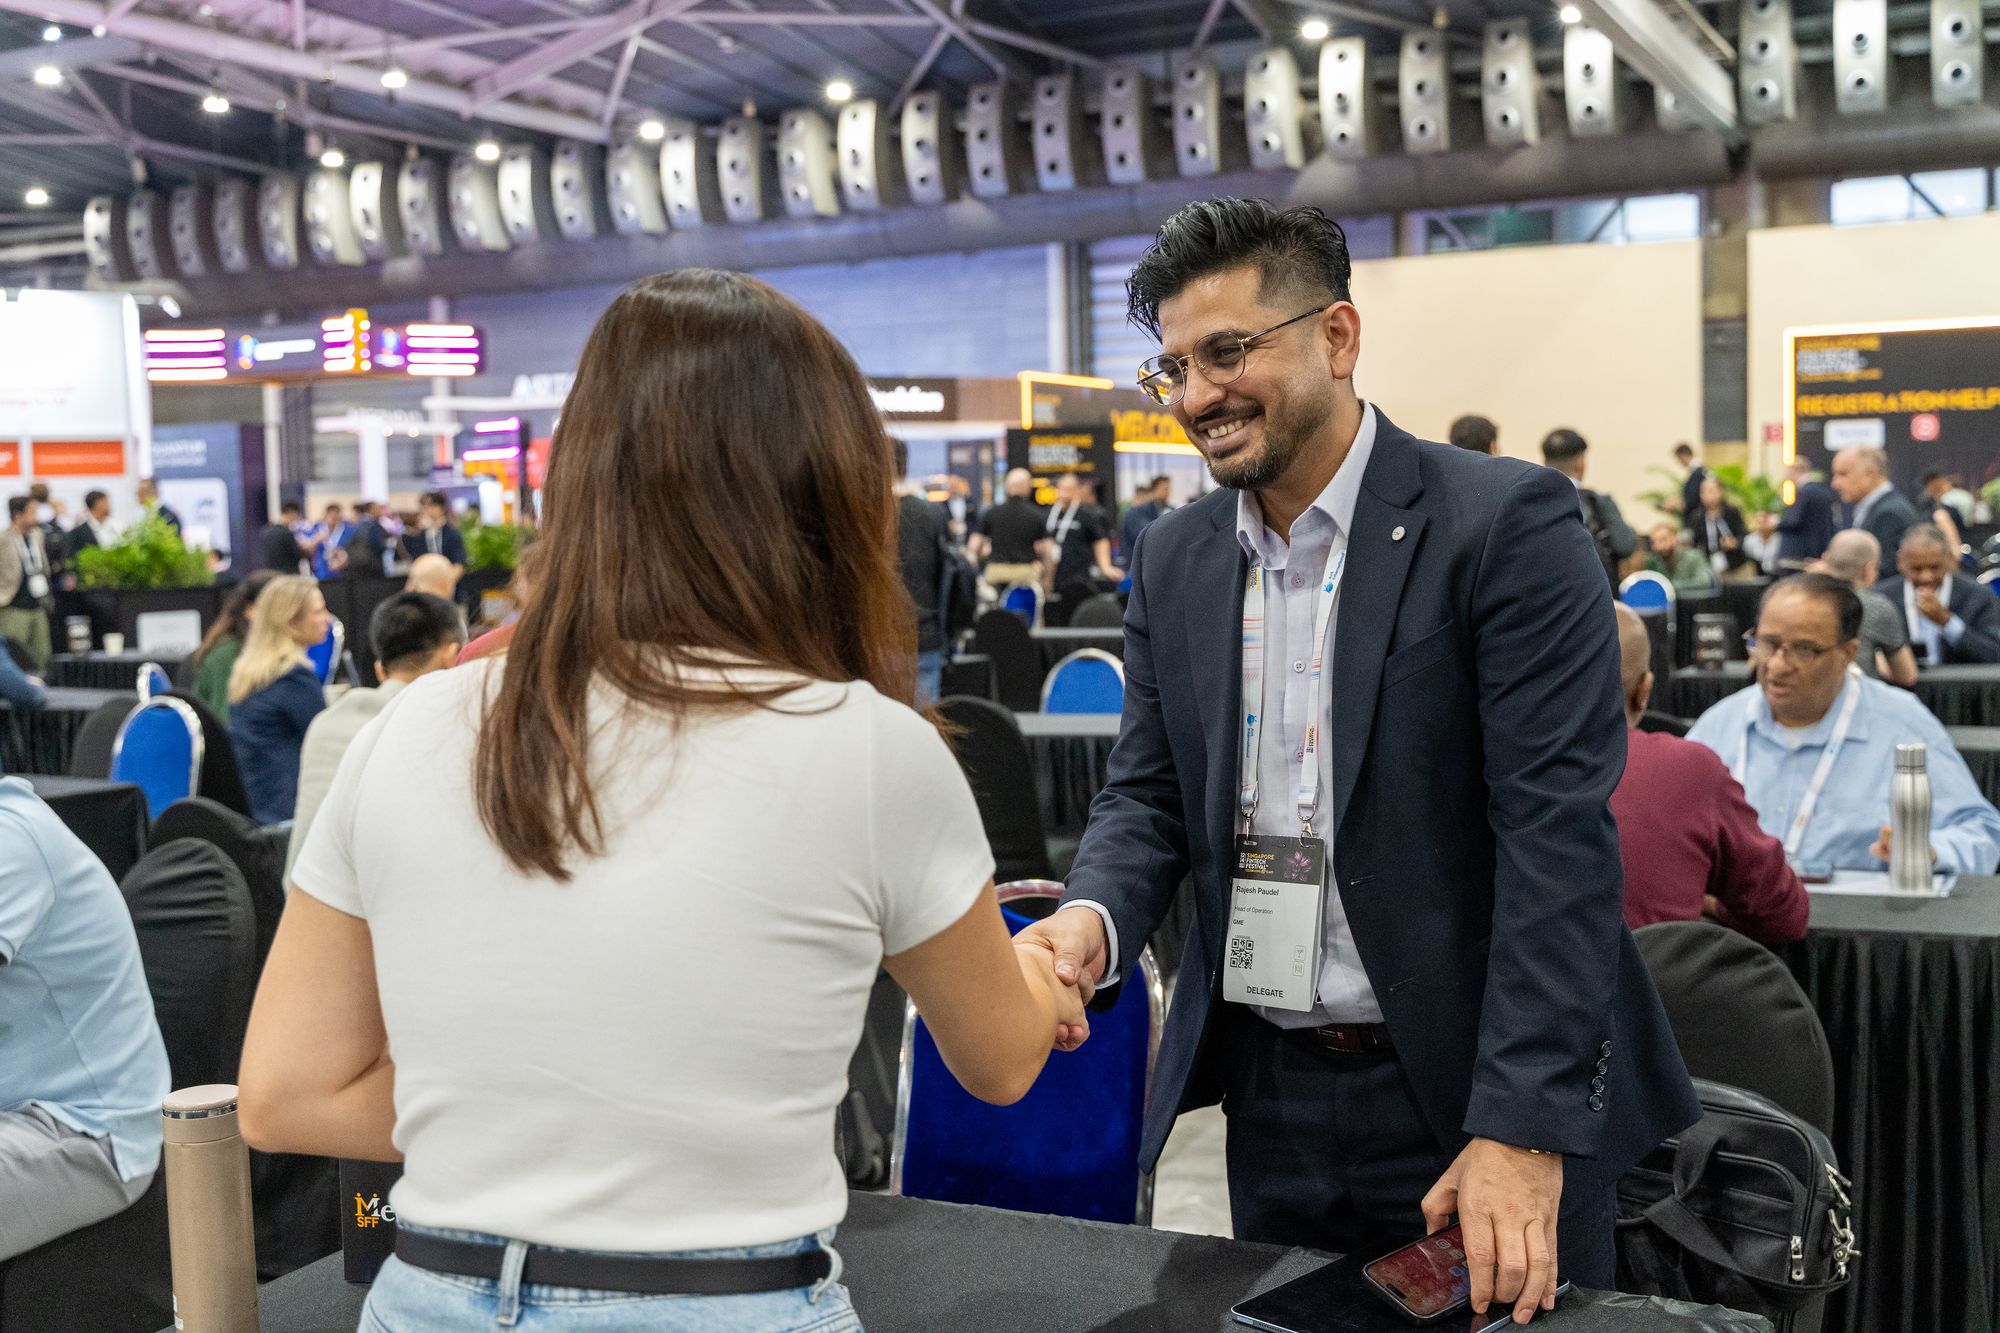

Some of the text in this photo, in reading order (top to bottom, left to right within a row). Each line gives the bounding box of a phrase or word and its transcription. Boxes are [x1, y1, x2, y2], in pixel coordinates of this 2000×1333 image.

[1247, 852, 1275, 861] SINGAPORE
[1236, 885, 1279, 896] Rajesh Paudel
[1246, 985, 1284, 998] DELEGATE
[357, 1216, 380, 1228] SFF
